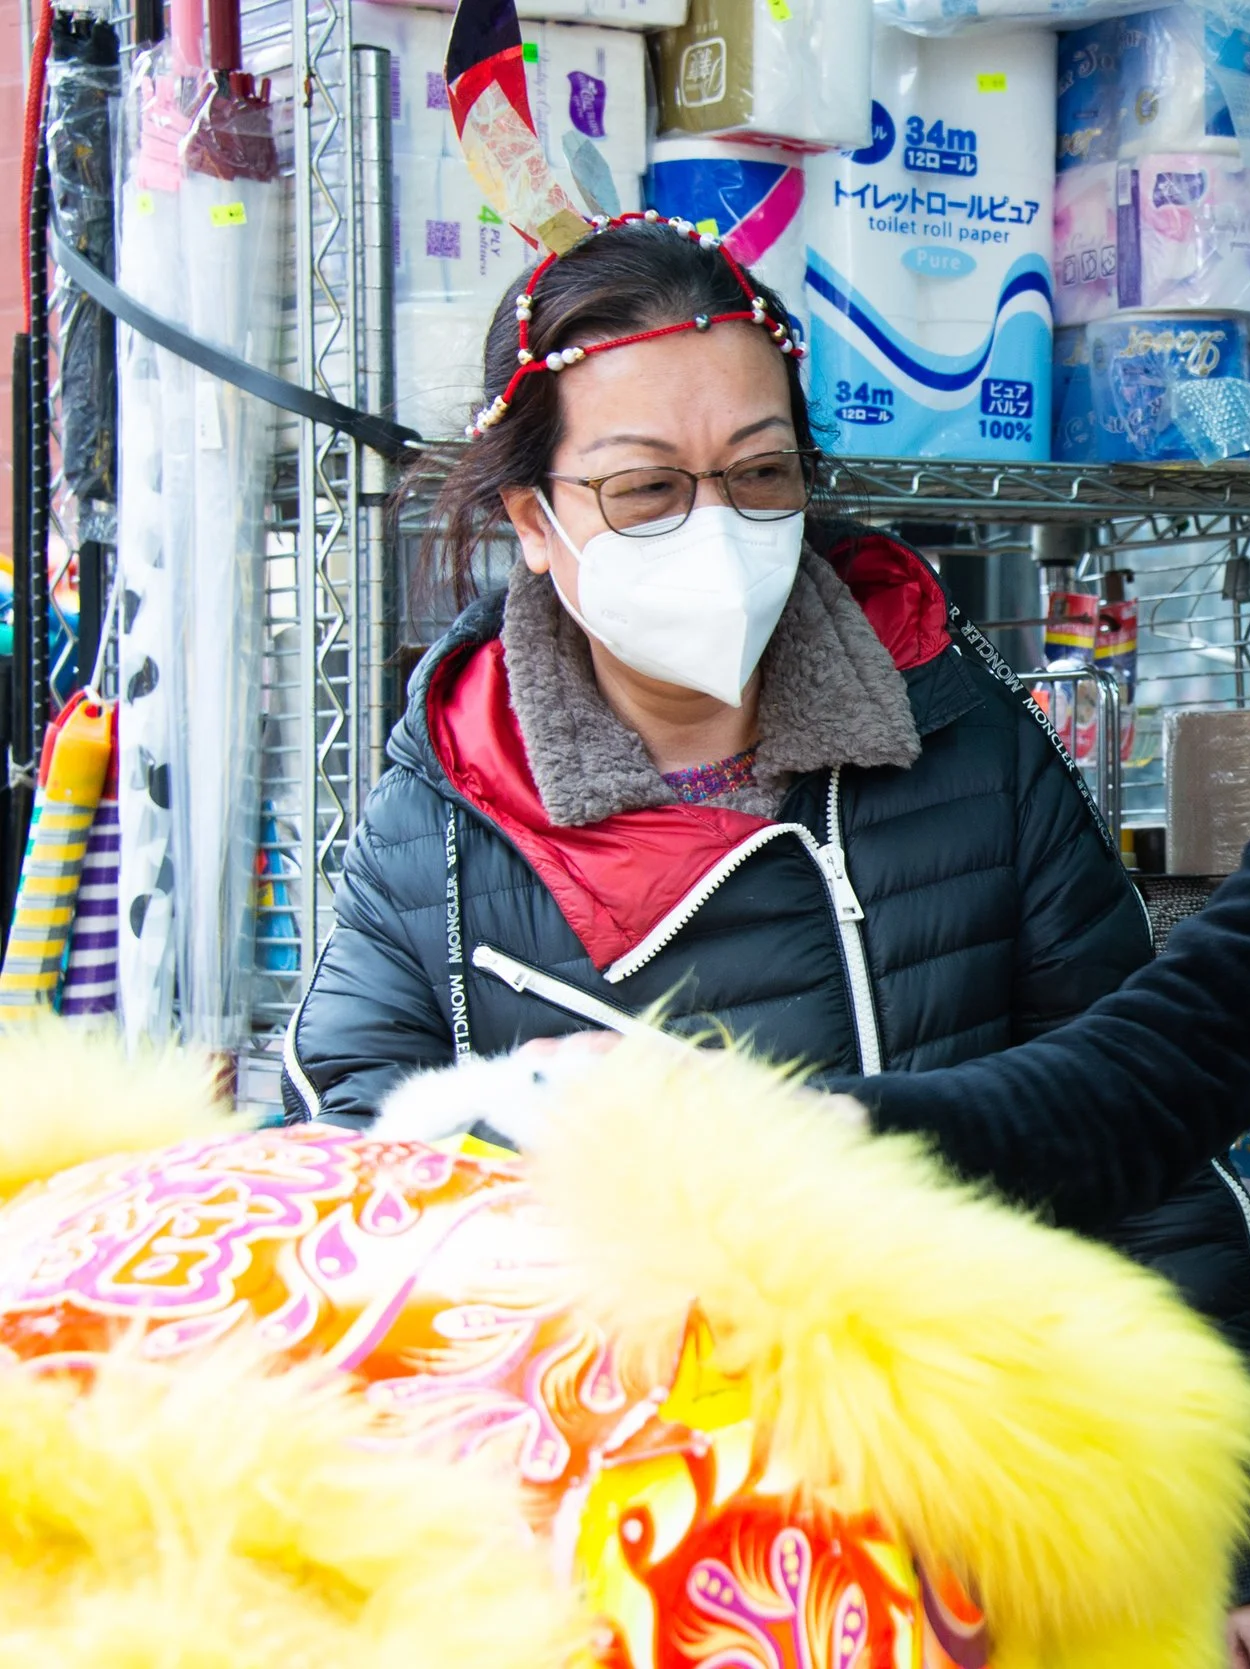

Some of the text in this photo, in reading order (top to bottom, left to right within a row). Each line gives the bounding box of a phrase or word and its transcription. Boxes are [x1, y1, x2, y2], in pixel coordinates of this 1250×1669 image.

[906, 116, 977, 152] 34m
[907, 151, 976, 172] 12ロール
[835, 180, 1039, 225] トイレットロールピュア
[477, 204, 503, 258] 4 PLY
[868, 216, 1010, 244] toilet roll paper
[916, 252, 962, 271] Pure
[834, 380, 894, 406] 34m
[990, 382, 1027, 399] ピュア
[841, 409, 891, 422] 12ロール
[979, 420, 1032, 442] 100%
[961, 619, 1024, 694] MONCLER
[1022, 697, 1075, 772] MONCLER
[446, 873, 463, 964] MONCLER
